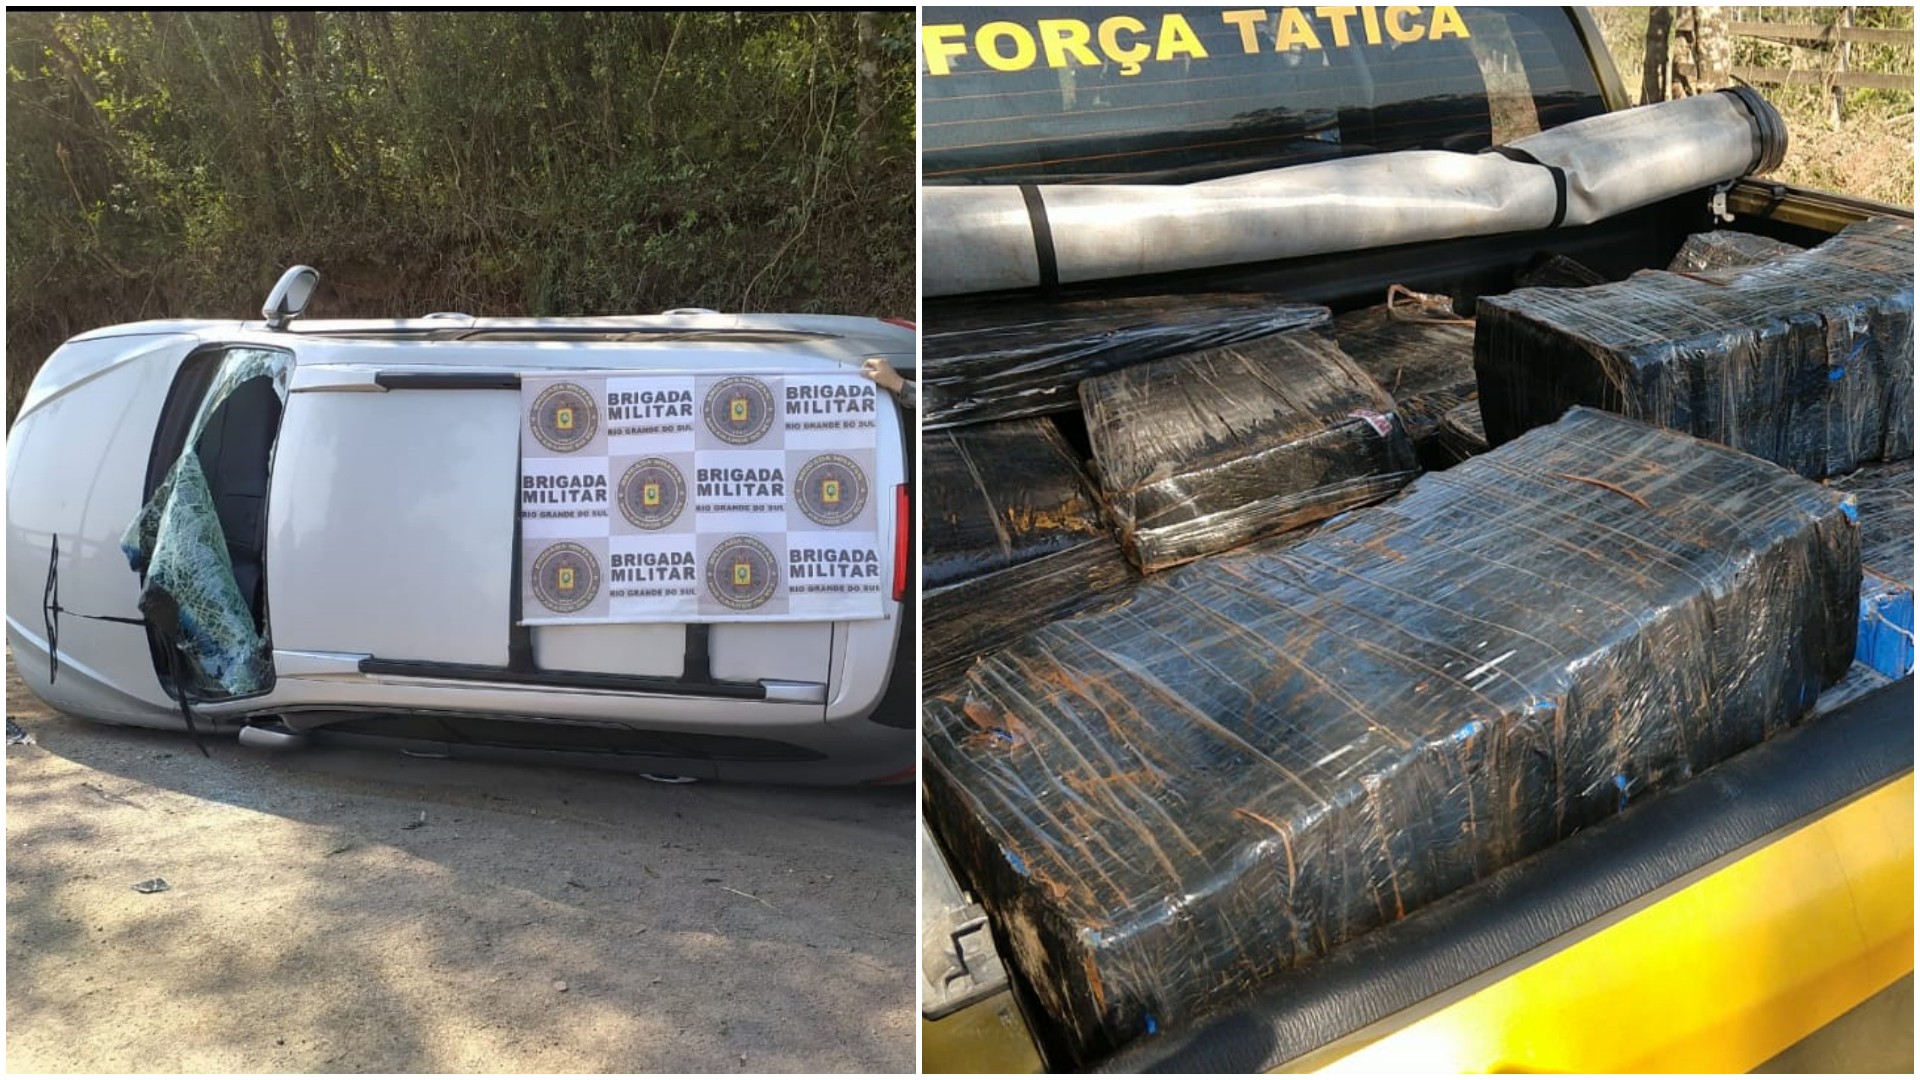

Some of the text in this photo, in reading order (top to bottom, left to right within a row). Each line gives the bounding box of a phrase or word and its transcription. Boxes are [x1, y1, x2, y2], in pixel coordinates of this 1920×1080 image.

[922, 13, 1208, 75] FORÇA
[608, 391, 692, 405] BRIGADA
[786, 385, 875, 399] BRIGADA
[608, 404, 692, 420] MILITAR
[786, 399, 875, 414] MILITAR
[608, 428, 622, 436] RIO
[625, 427, 660, 435] GRANDE
[523, 475, 607, 488] BRIGADA
[697, 468, 784, 482] BRIGADA
[523, 489, 607, 503] MILITAR
[697, 483, 784, 496] MILITAR
[611, 552, 695, 567] BRIGADA
[790, 549, 878, 563] BRIGADA
[611, 567, 695, 582] MILITAR
[790, 564, 878, 578] MILITAR
